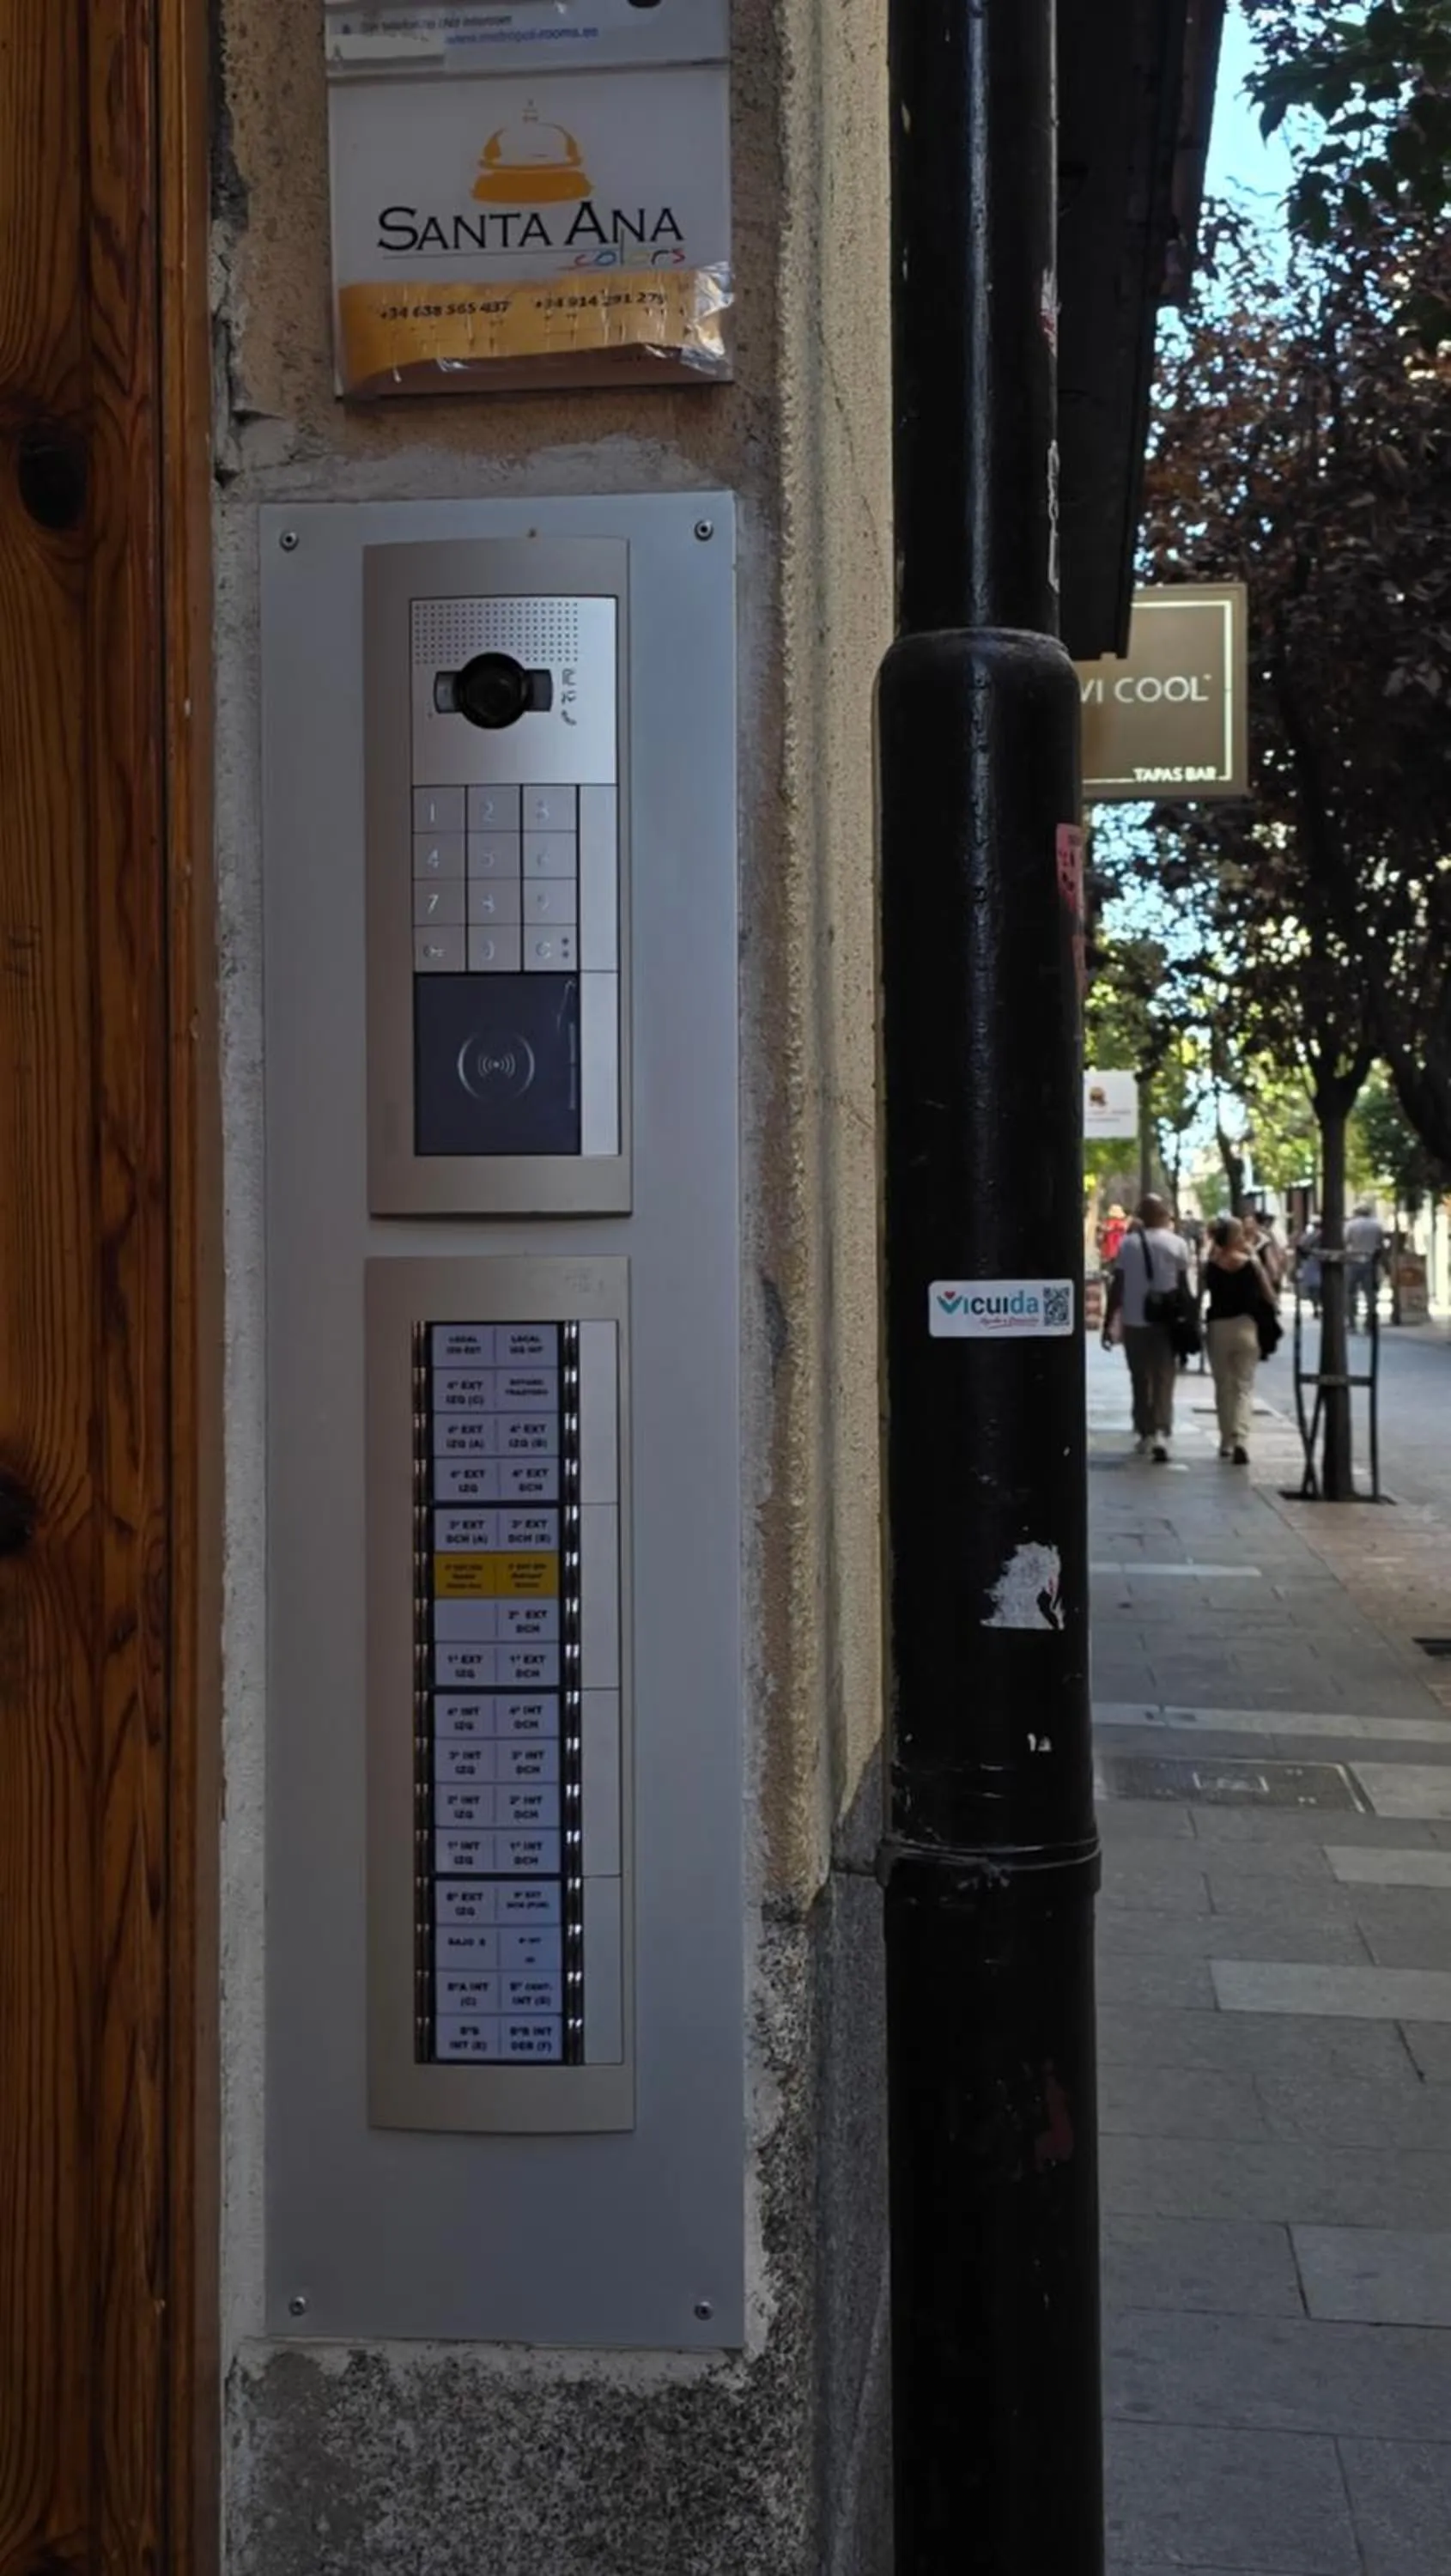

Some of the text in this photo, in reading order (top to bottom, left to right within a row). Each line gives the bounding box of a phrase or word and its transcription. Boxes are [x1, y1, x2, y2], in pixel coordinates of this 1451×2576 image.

[377, 200, 684, 252] SANTA ANA
[1114, 676, 1209, 702] COOL
[1132, 766, 1217, 782] TAPAS BAR
[461, 1381, 483, 1390] EXT
[446, 1395, 465, 1405] IZQ
[461, 1425, 483, 1434] EXT
[524, 1424, 546, 1433] EXT
[446, 1439, 465, 1449] IZQ
[508, 1438, 528, 1448] IZQ
[464, 1469, 485, 1479] EXT
[526, 1468, 549, 1478] EXT
[458, 1484, 478, 1493] IZQ
[519, 1483, 543, 1492] DCH
[462, 1520, 484, 1529] EXT
[525, 1520, 548, 1529] EXT
[446, 1535, 470, 1544] DCH
[508, 1534, 532, 1543] DCH
[525, 1610, 548, 1619] EXT
[516, 1625, 540, 1633] DCH
[461, 1655, 483, 1663] EXT
[524, 1655, 545, 1663] EXT
[516, 1669, 540, 1678] DCH
[461, 1893, 483, 1901] EXT
[470, 1982, 489, 1991] INT
[533, 2026, 552, 2035] INT
